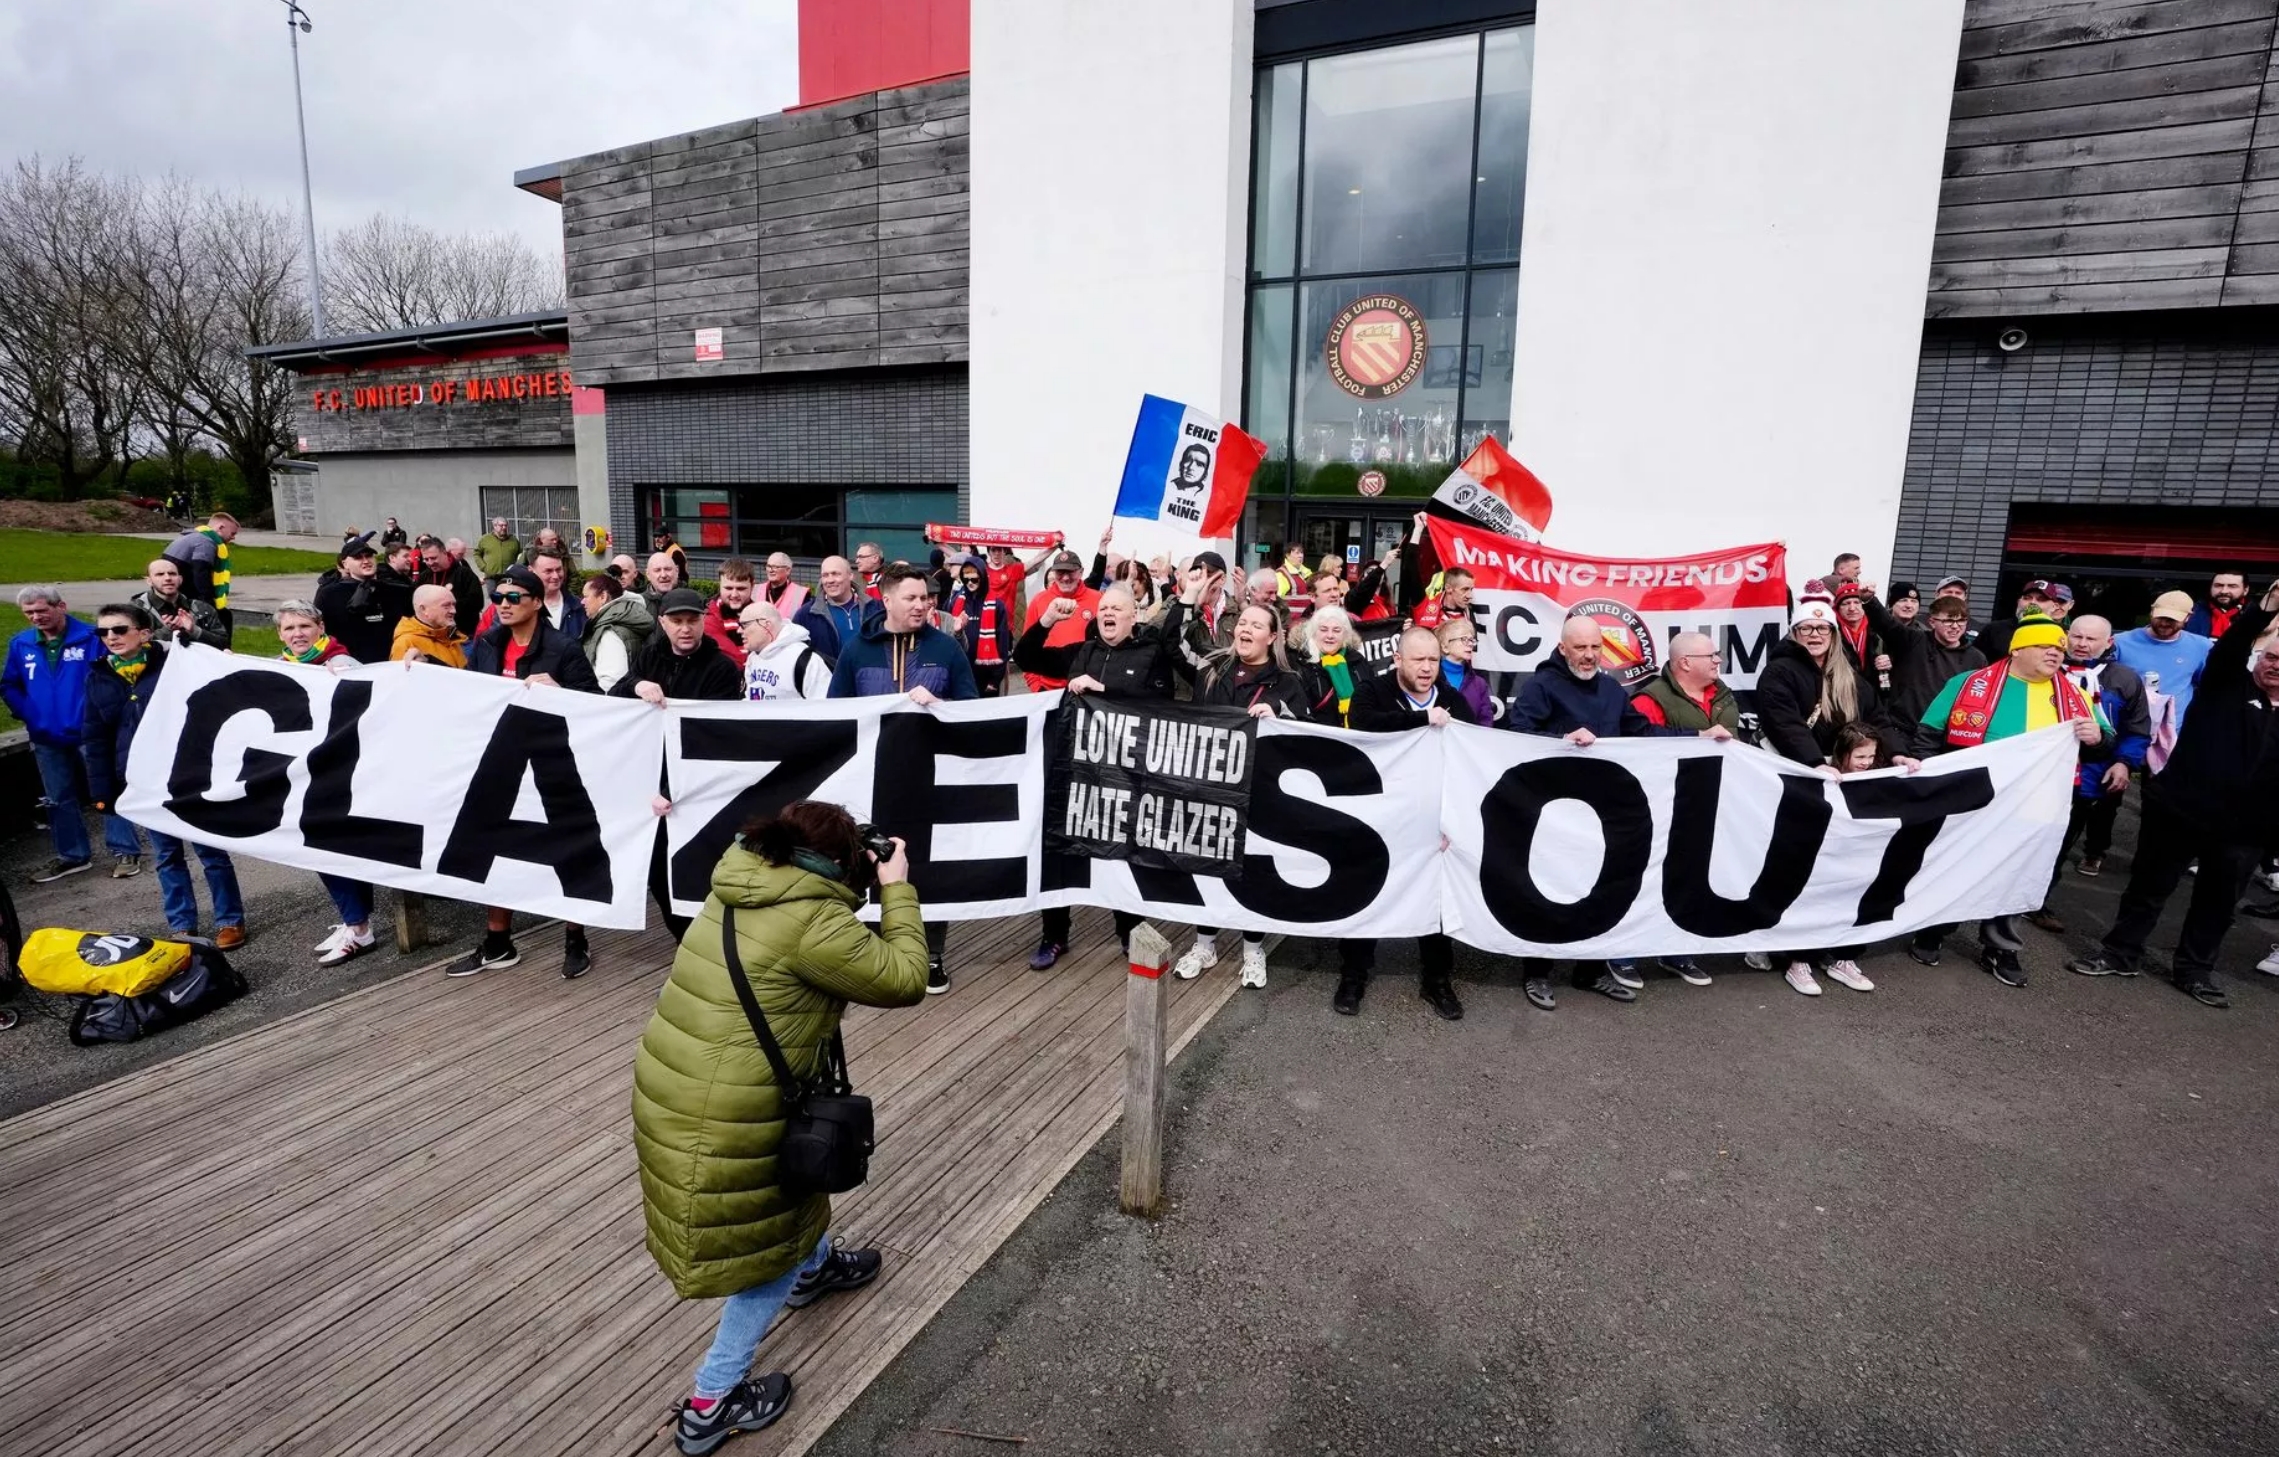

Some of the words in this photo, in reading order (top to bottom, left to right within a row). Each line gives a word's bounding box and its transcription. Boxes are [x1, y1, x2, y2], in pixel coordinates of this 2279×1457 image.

[1352, 298, 1397, 315] UNITED
[1398, 305, 1414, 320] OF
[1330, 312, 1353, 343] CLUB
[1328, 346, 1366, 396] FOOTBALL
[1382, 319, 1425, 395] MANCHESTER
[313, 389, 348, 411] F.C.
[354, 383, 424, 409] UNITED
[430, 380, 457, 404] OF
[1185, 422, 1218, 443] ERIC
[1167, 502, 1201, 522] KING
[1176, 496, 1196, 508] THE
[1452, 536, 1599, 588] MAKING
[1604, 554, 1769, 589] FRIENDS
[1471, 603, 1542, 656] FC
[1578, 603, 1620, 616] UNITED
[1622, 612, 1638, 626] OF
[24, 661, 37, 681] 7
[1073, 707, 1141, 769] LOVE
[1145, 718, 1248, 784] UNITED
[1065, 782, 1132, 843] HATE
[1135, 793, 1238, 861] GLAZER
[1480, 755, 1995, 944] OUT
